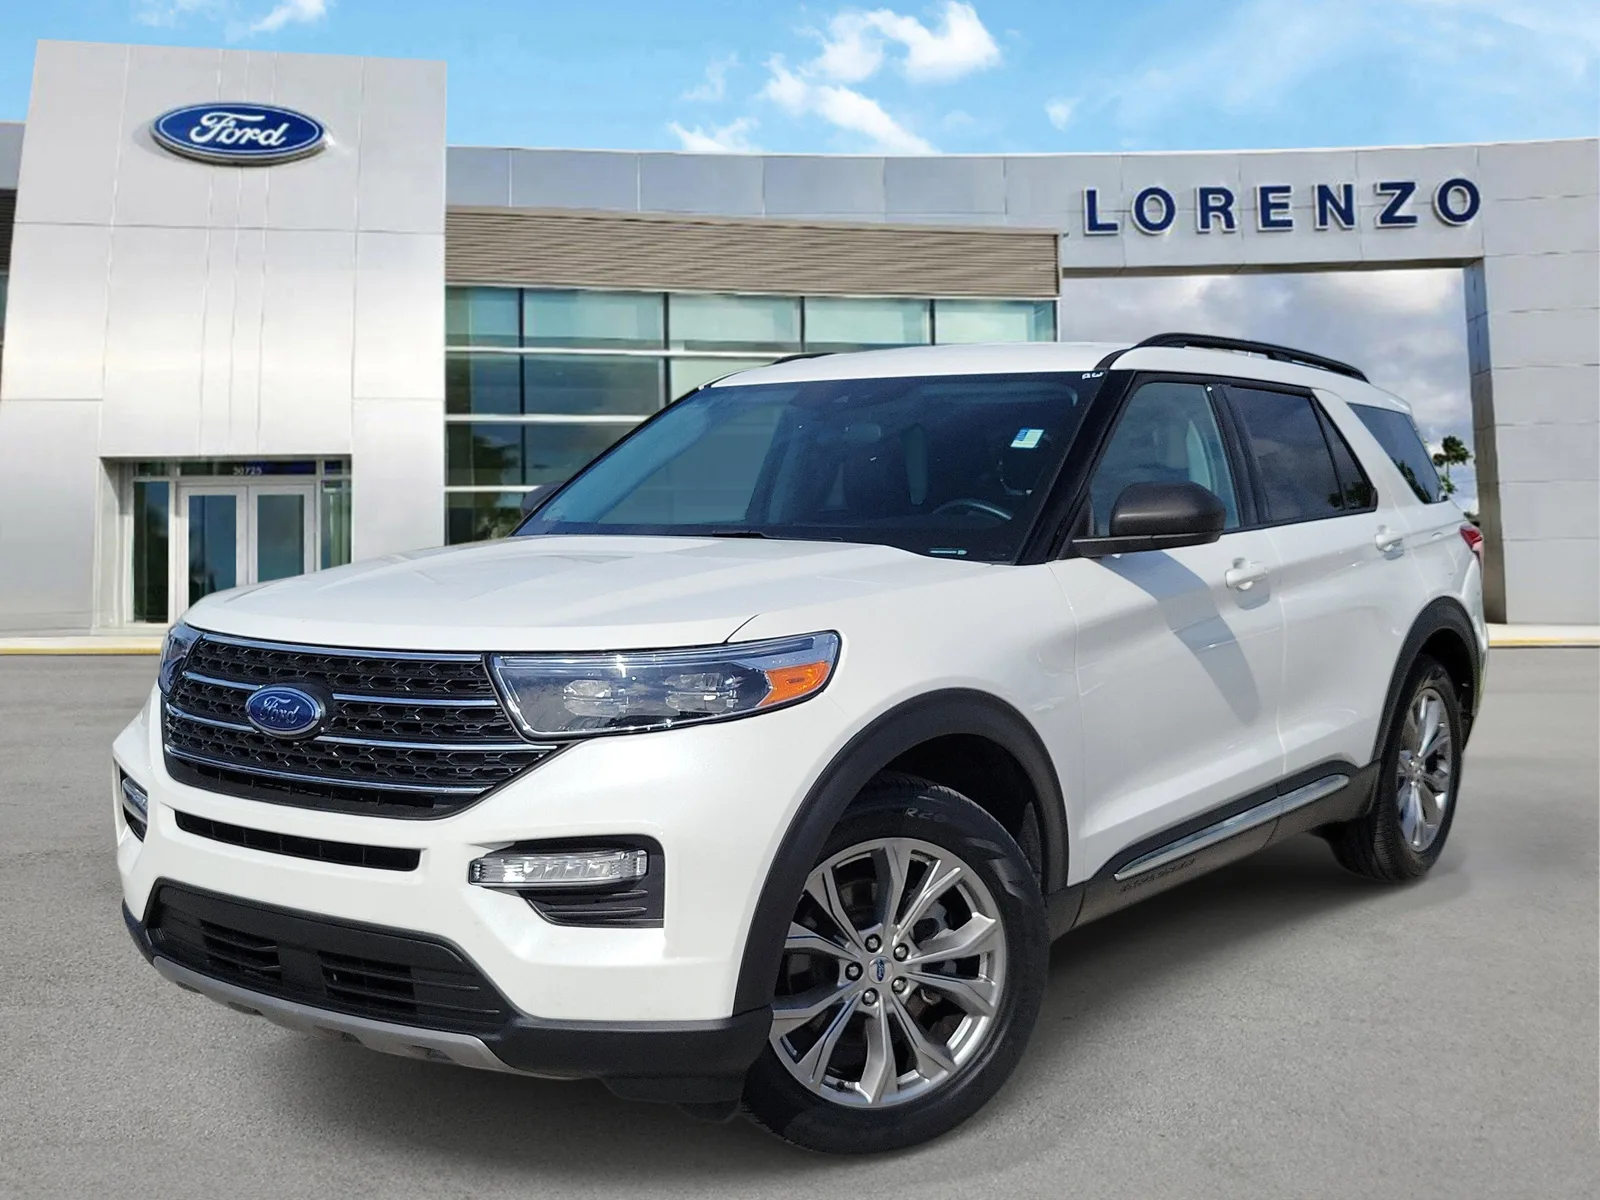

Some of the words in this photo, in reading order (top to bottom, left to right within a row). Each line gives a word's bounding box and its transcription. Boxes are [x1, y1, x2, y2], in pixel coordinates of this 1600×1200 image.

[189, 111, 290, 147] Ford
[1083, 178, 1481, 235] LORENZO
[260, 695, 301, 724] Ford
